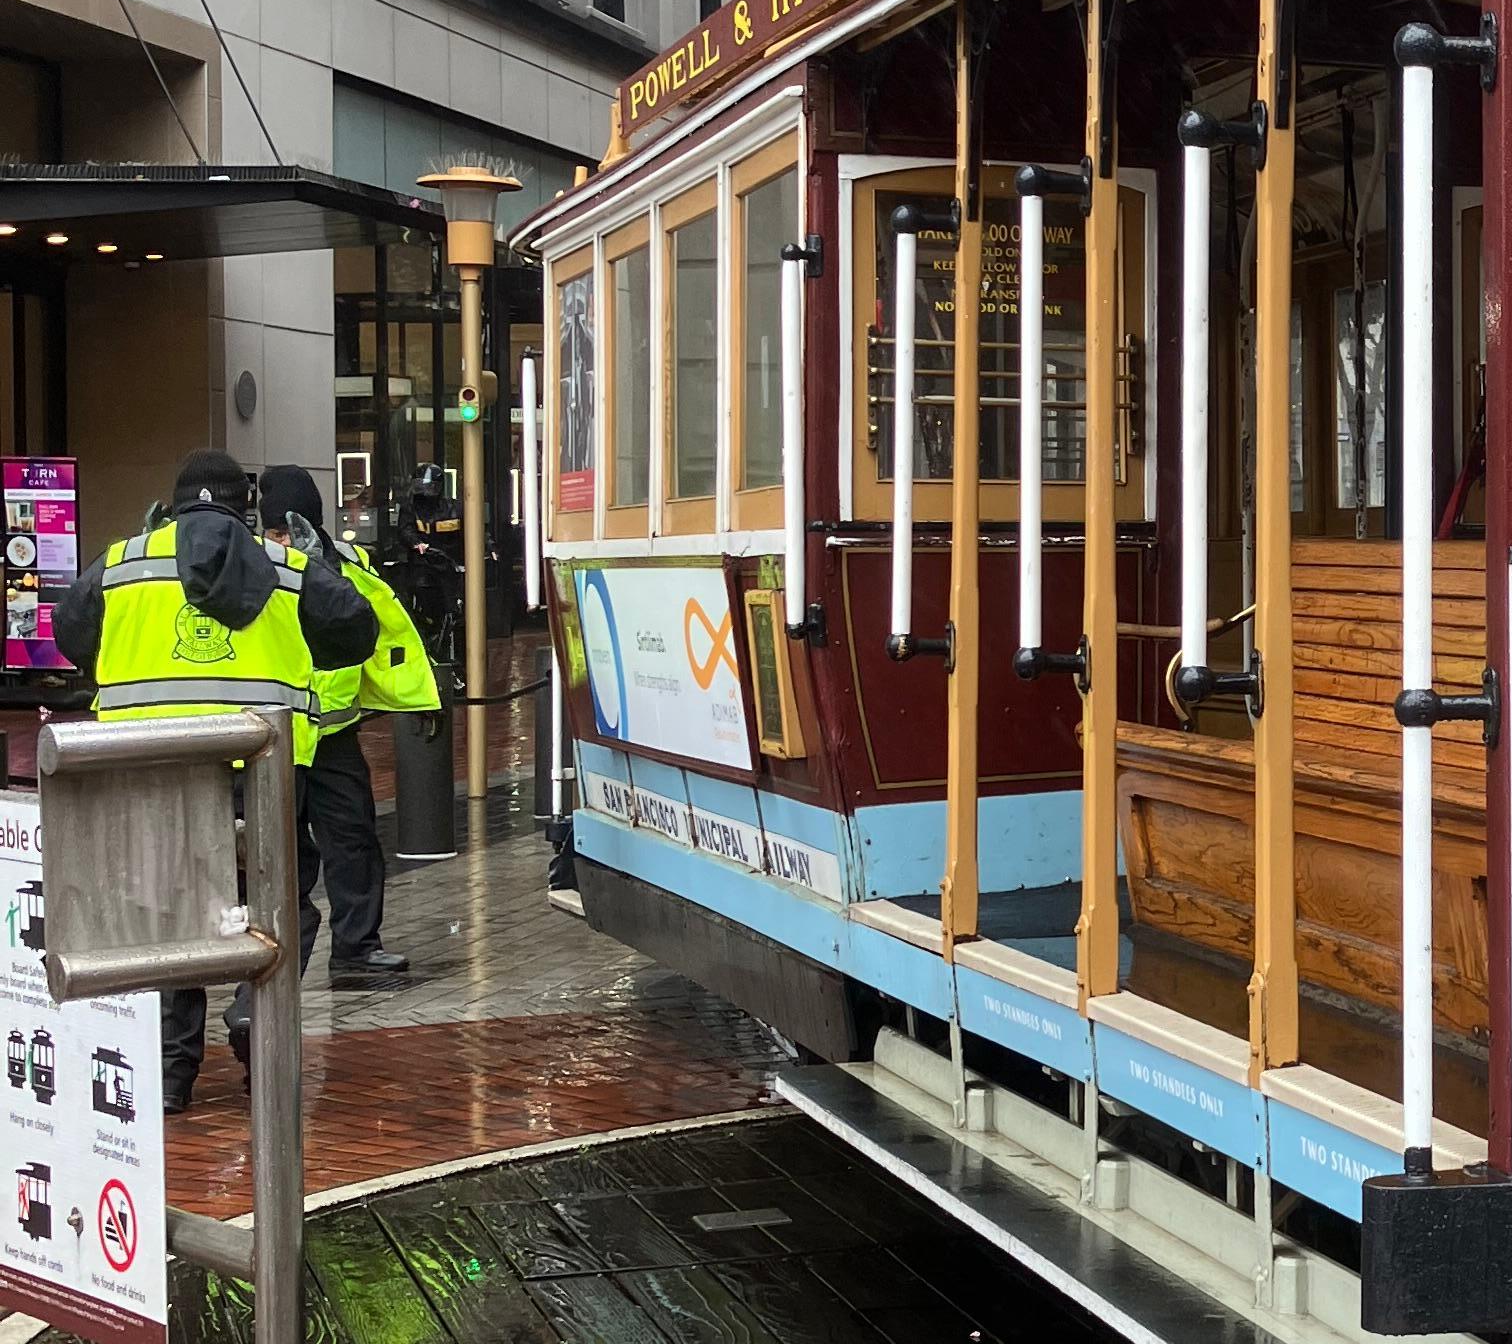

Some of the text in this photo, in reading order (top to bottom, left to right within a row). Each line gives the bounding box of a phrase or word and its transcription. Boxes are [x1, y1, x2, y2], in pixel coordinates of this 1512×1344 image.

[629, 30, 720, 120] POWELL
[733, 0, 754, 46] &
[1043, 226, 1074, 244] WAY
[933, 260, 1017, 273] KEE LLOW
[981, 247, 1003, 257] OLD
[603, 781, 625, 815] SAN
[983, 994, 1062, 1041] TWO STANDEES ONLY
[1129, 1059, 1224, 1118] TWO STANDEES ONLY
[1300, 1136, 1327, 1165] TWO
